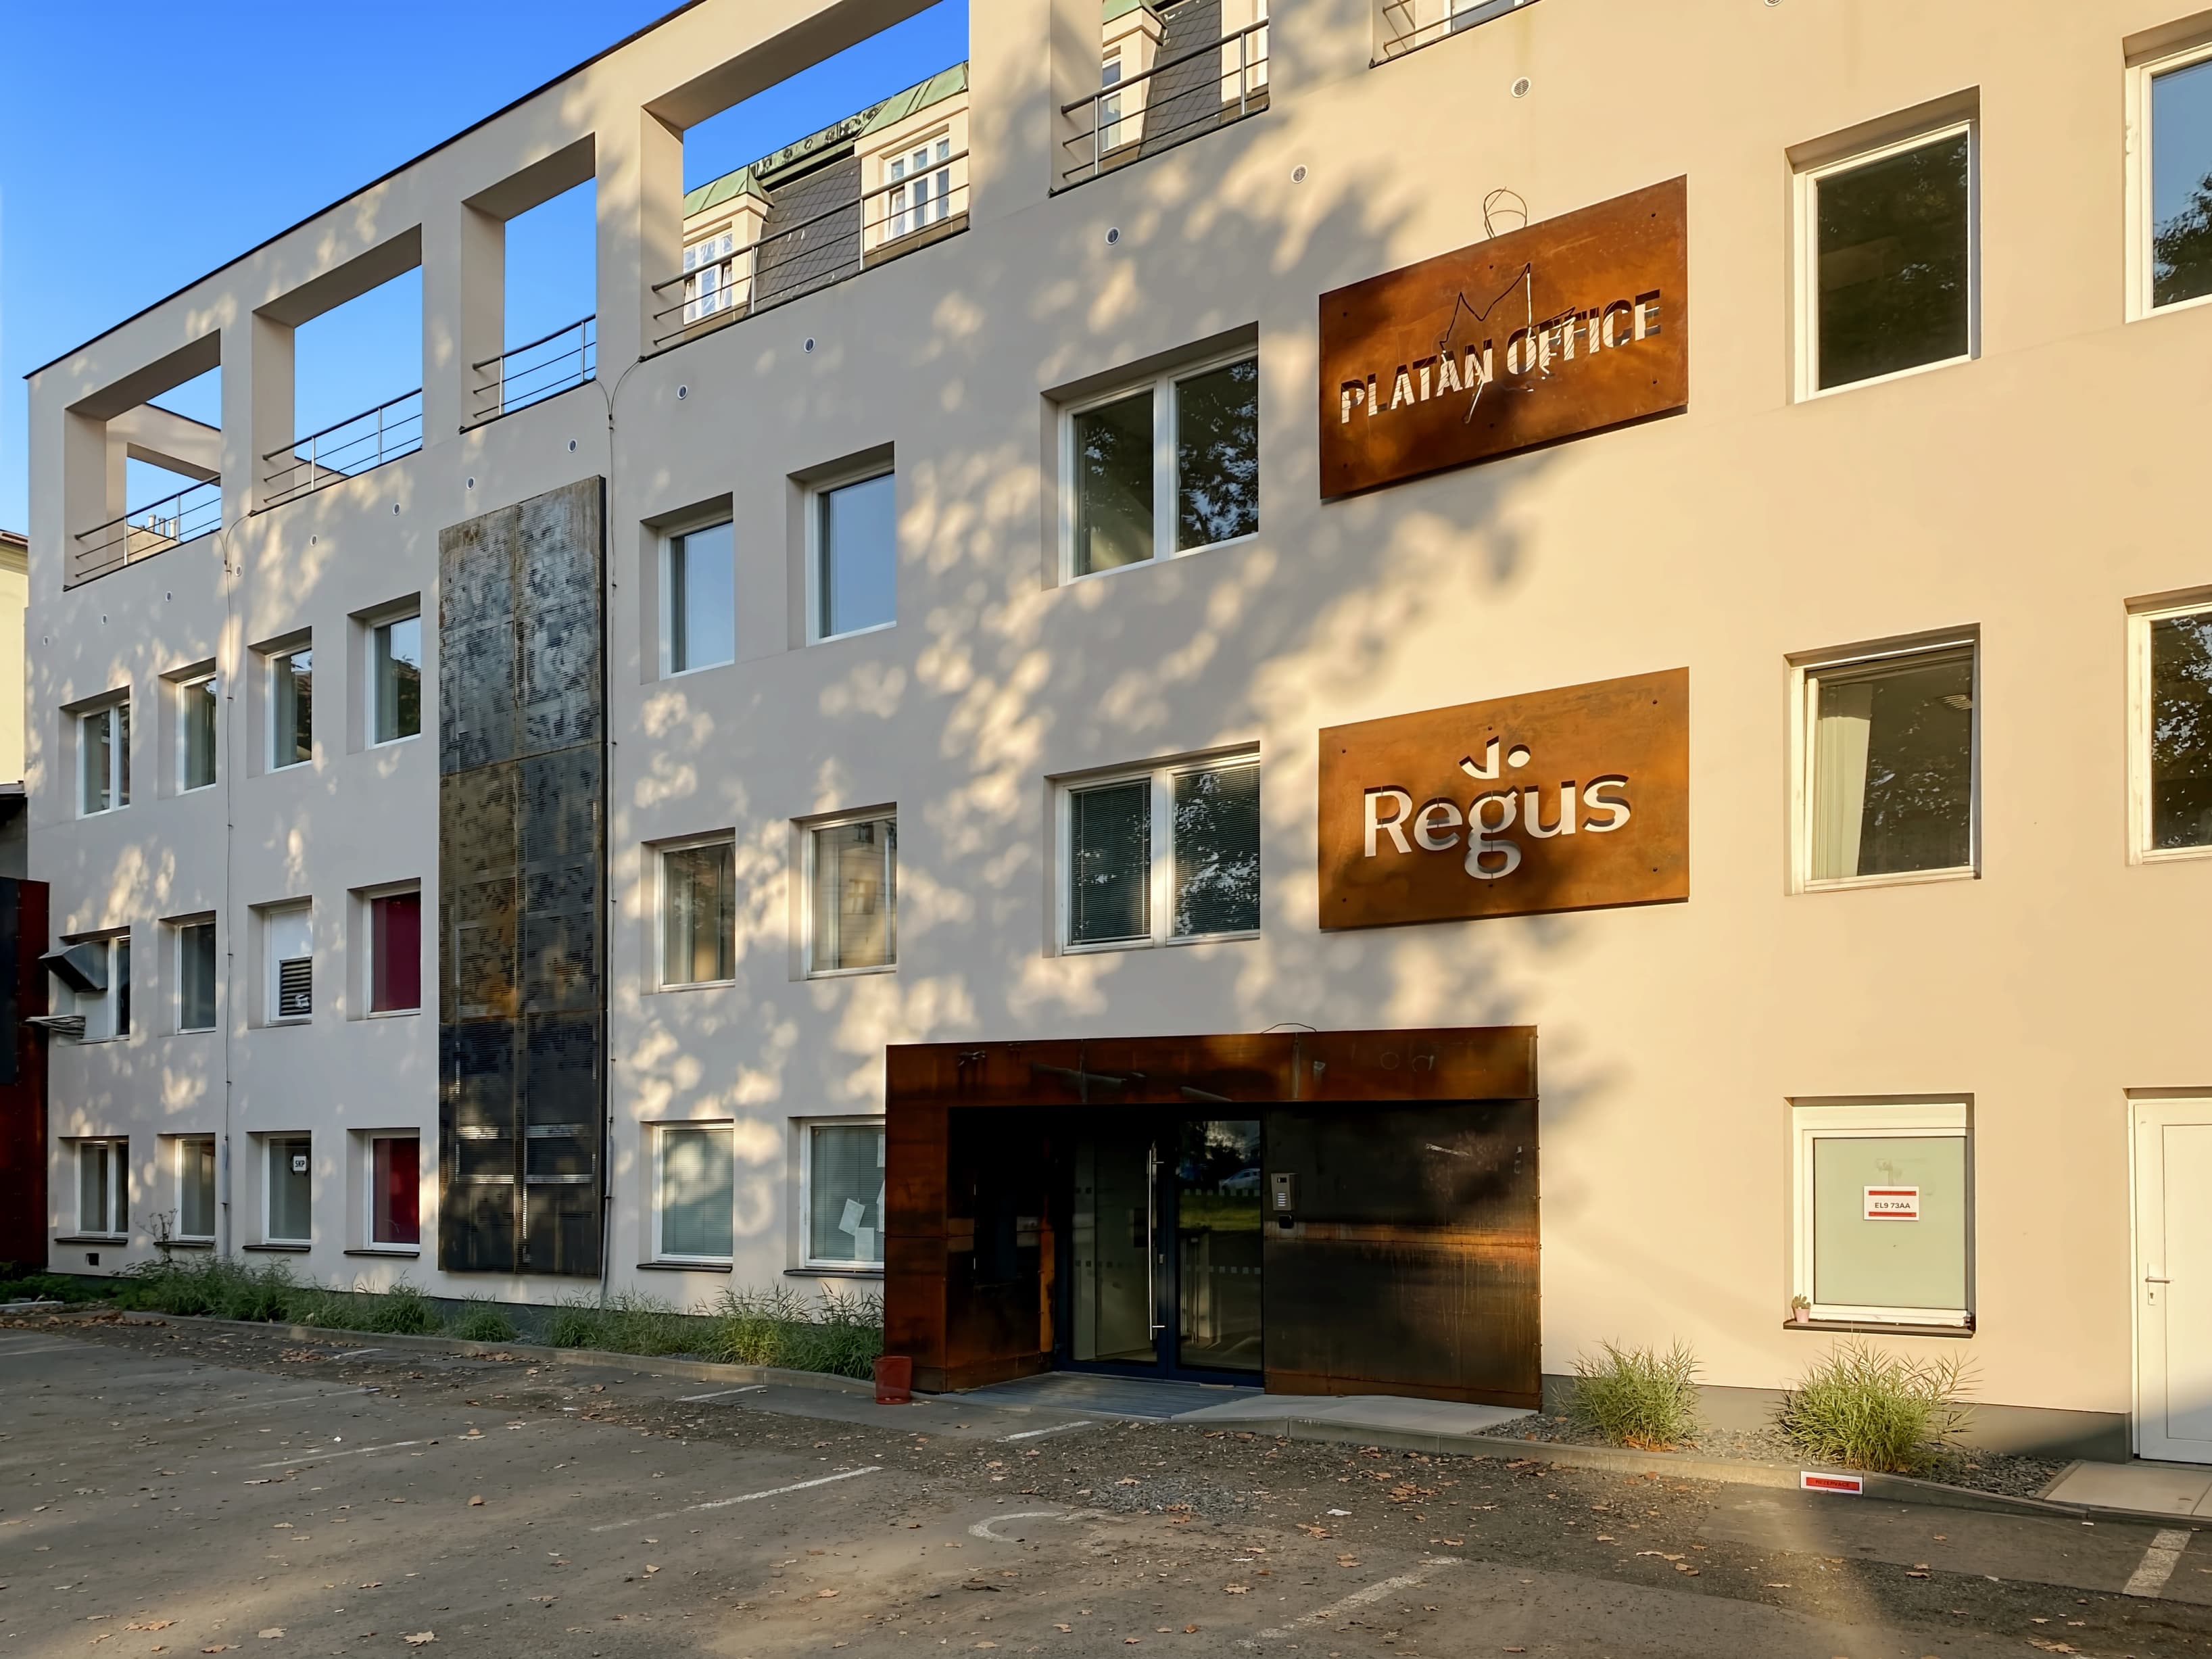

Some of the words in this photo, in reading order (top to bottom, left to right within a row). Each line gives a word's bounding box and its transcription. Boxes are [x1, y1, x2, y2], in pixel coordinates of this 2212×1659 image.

[1340, 339, 1493, 424] PLATAN
[1507, 289, 1661, 376] OFFICE
[1364, 774, 1631, 880] Regus
